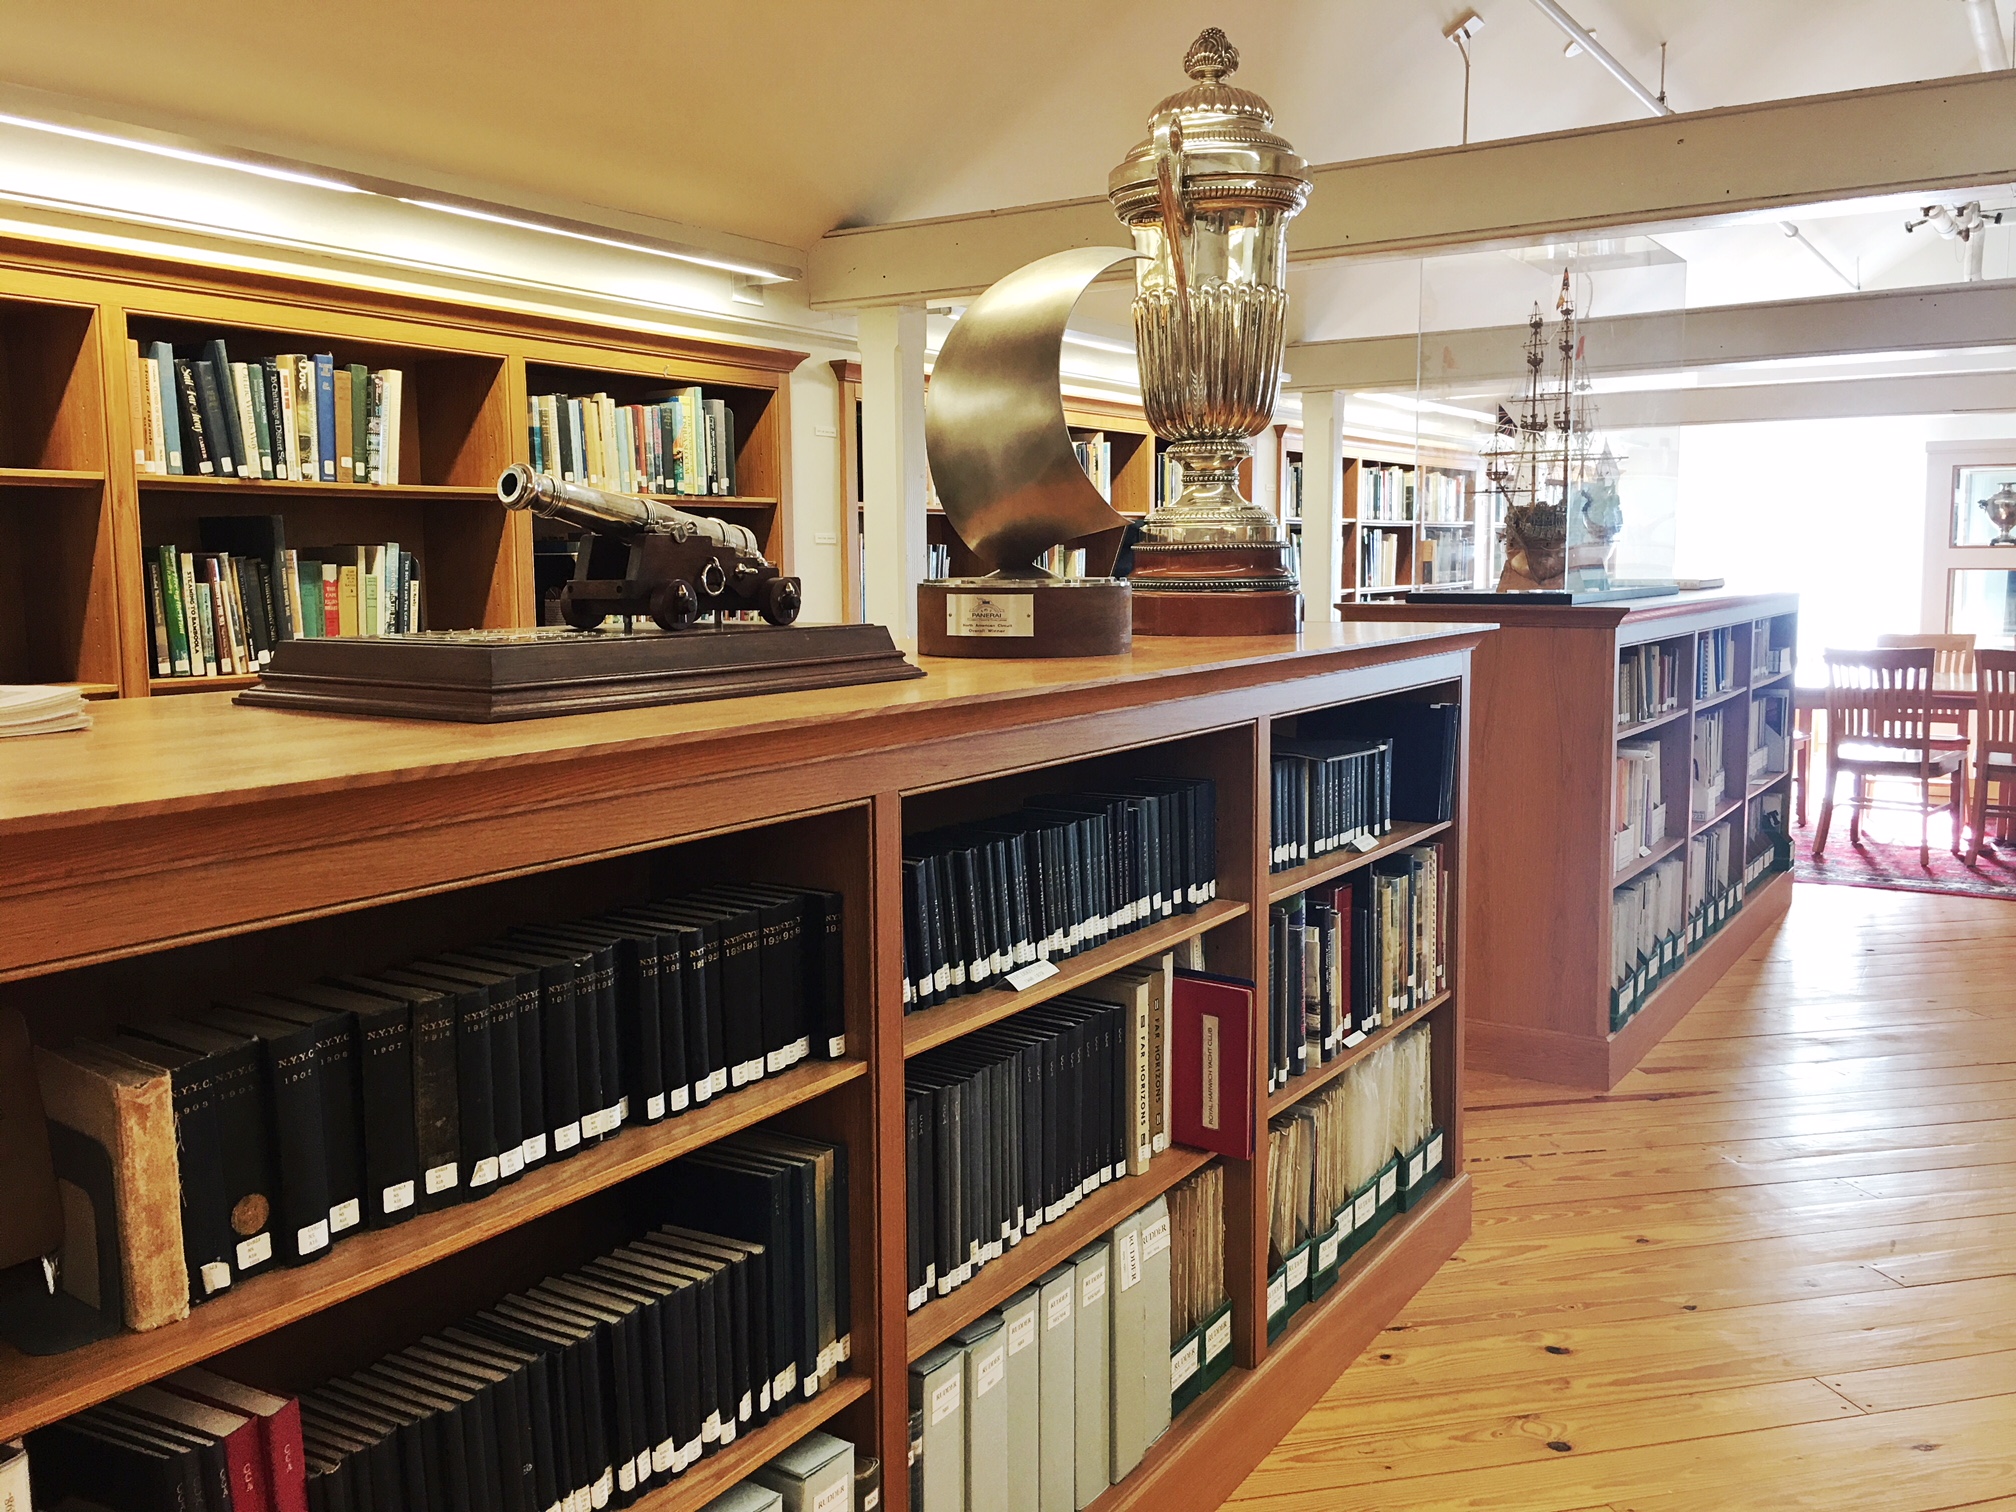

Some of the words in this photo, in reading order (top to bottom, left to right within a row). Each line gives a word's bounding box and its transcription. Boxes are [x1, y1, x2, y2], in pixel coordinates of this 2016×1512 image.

[180, 365, 195, 387] Sail
[298, 359, 309, 392] Dove
[270, 382, 279, 418] Challenge
[275, 425, 284, 451] Distant
[186, 571, 194, 606] STEAMING
[190, 606, 196, 616] TO
[191, 615, 200, 655] BAMBOOLA
[373, 1042, 402, 1056] 1907
[1142, 1224, 1167, 1245] RUDDER
[1128, 1234, 1137, 1282] RUDDER
[1085, 1271, 1103, 1287] RUDDER
[1050, 1292, 1069, 1309] RUDDER
[1011, 1317, 1032, 1335] RUDDER
[1207, 1320, 1227, 1343] RUDDER
[982, 1356, 1001, 1373] RUDDER
[1174, 1347, 1196, 1371] RUDDER
[936, 1381, 957, 1401] RUDDER
[284, 1443, 293, 1473] CCA
[243, 1462, 254, 1493] CCA
[818, 1485, 845, 1509] RUDDER
